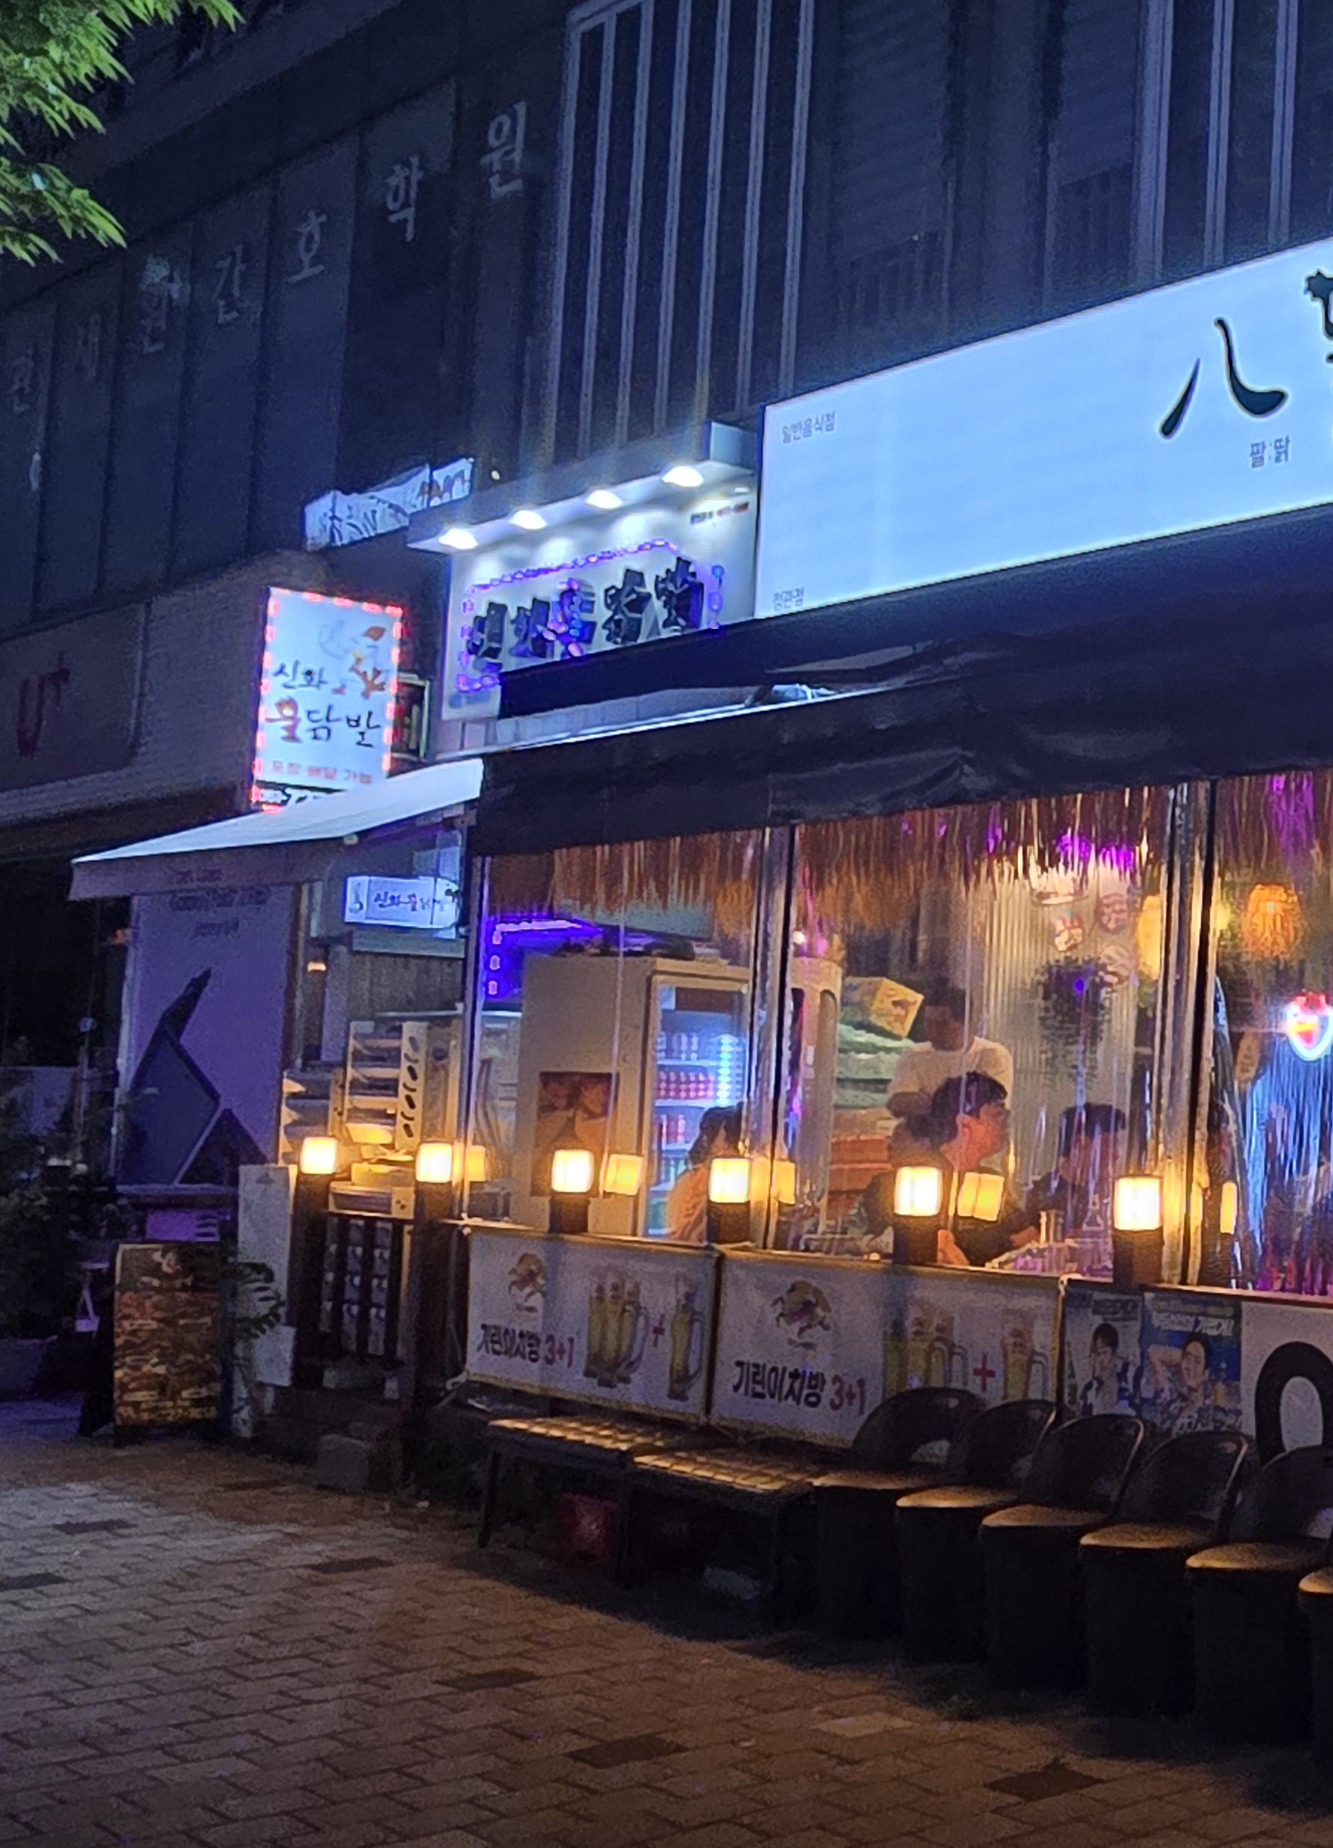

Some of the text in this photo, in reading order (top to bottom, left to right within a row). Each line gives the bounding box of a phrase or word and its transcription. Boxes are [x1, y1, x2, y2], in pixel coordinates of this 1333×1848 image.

[782, 411, 836, 444] 일반음식점
[273, 659, 328, 690] 신화
[477, 1322, 576, 1369] 기린이치방 3+1
[732, 1360, 867, 1415] 기린이치방 3+1
